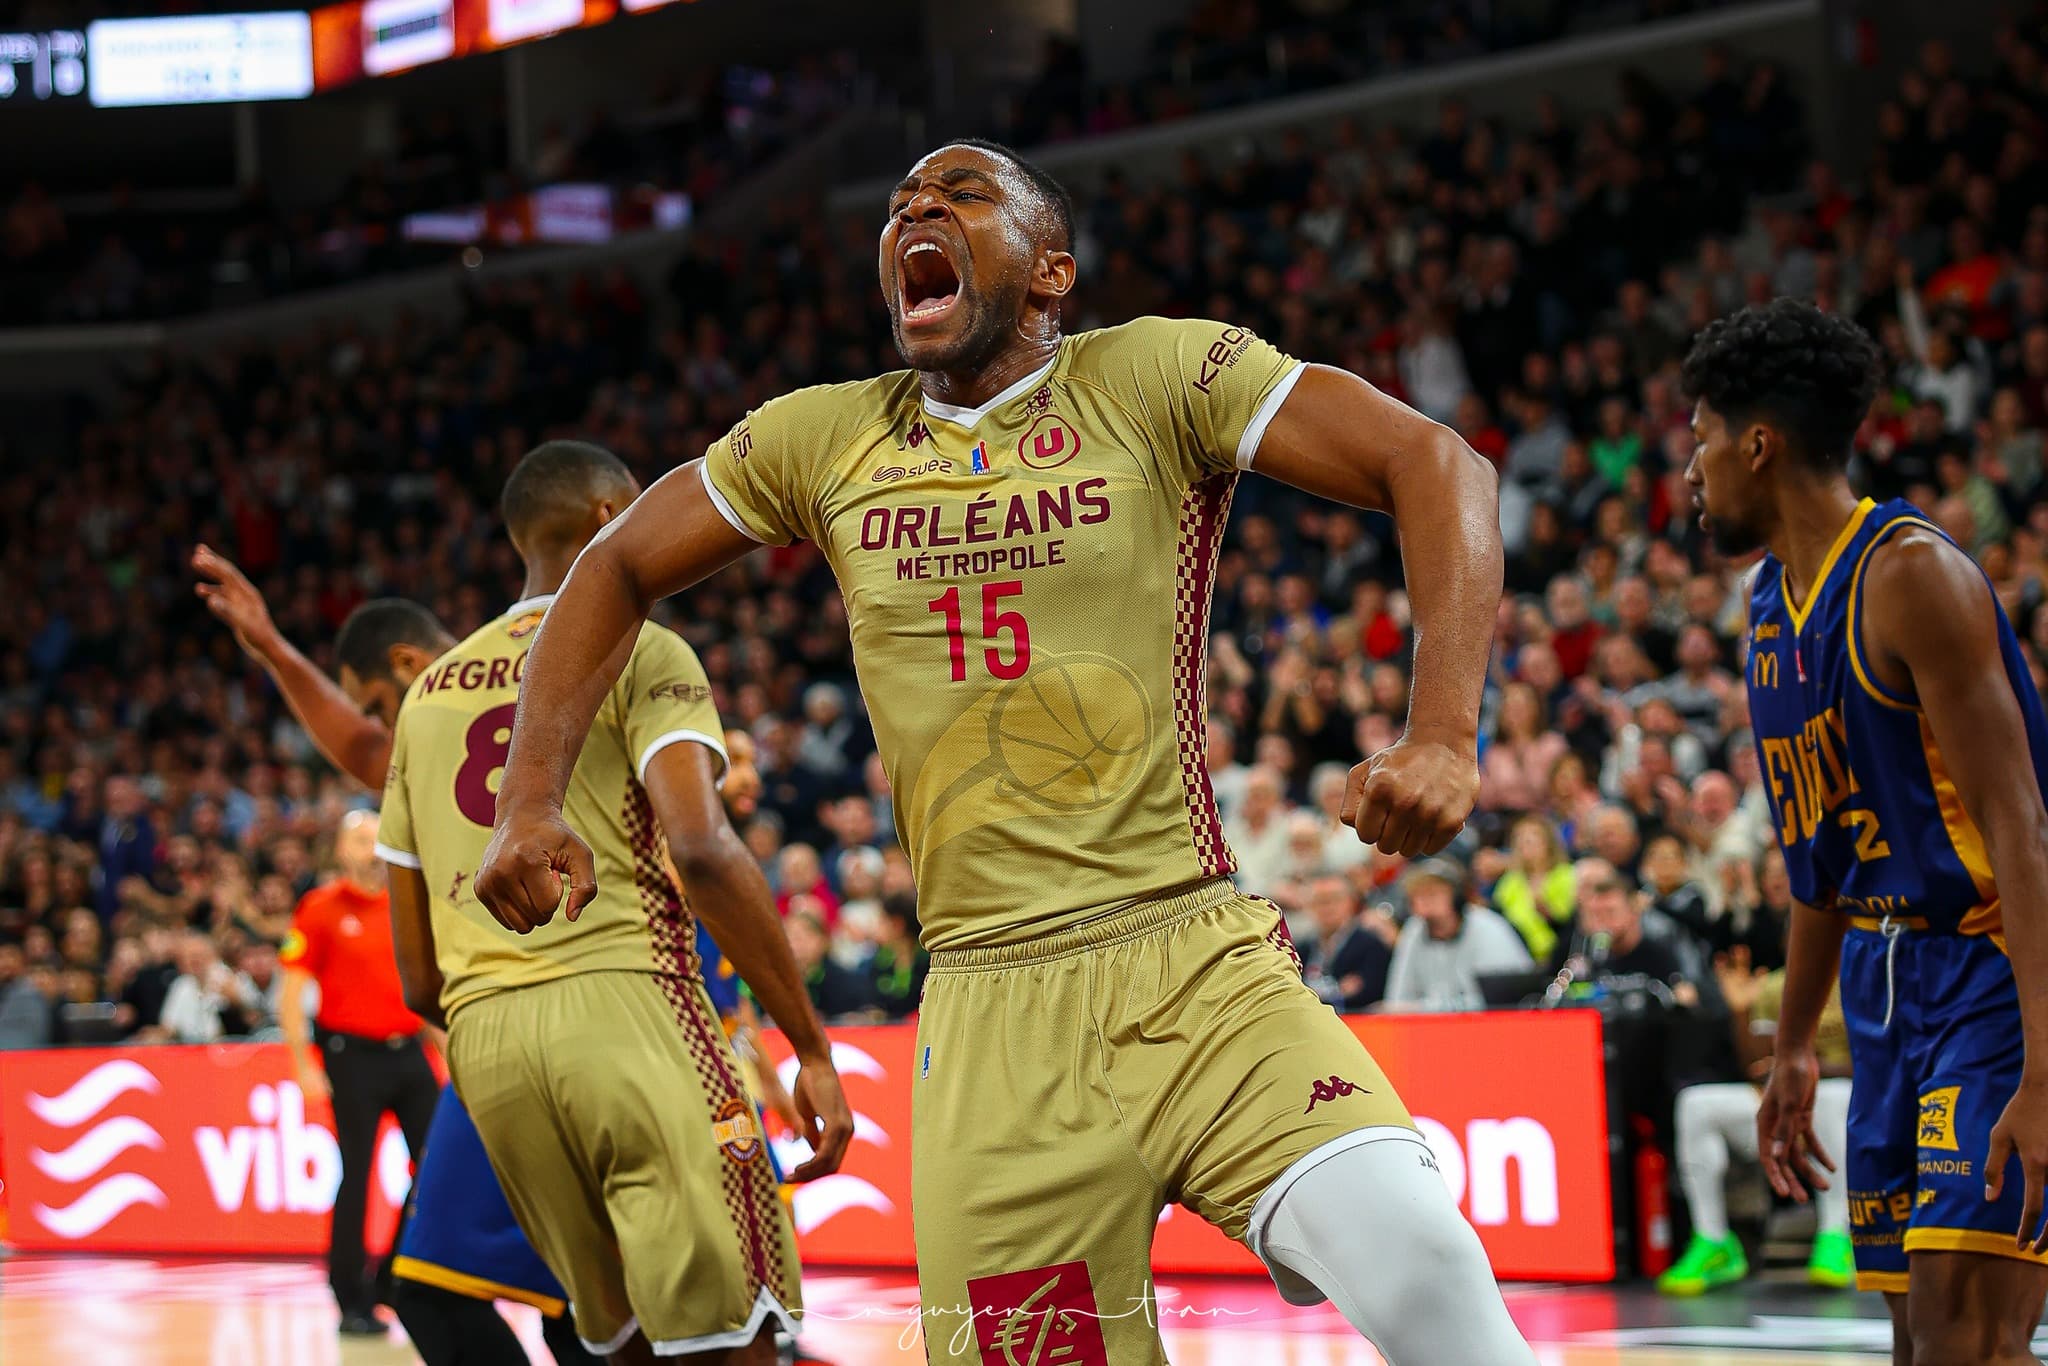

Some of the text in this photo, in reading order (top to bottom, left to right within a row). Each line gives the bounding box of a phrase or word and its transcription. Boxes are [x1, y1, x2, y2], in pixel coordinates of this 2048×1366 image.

[1034, 427, 1064, 458] U
[860, 477, 1111, 551] ORLÉANS
[896, 539, 1066, 581] MÉTROPOLE
[927, 579, 1032, 682] 15
[454, 702, 521, 828] 8
[1838, 808, 1892, 863] 2
[193, 1080, 346, 1214] vib
